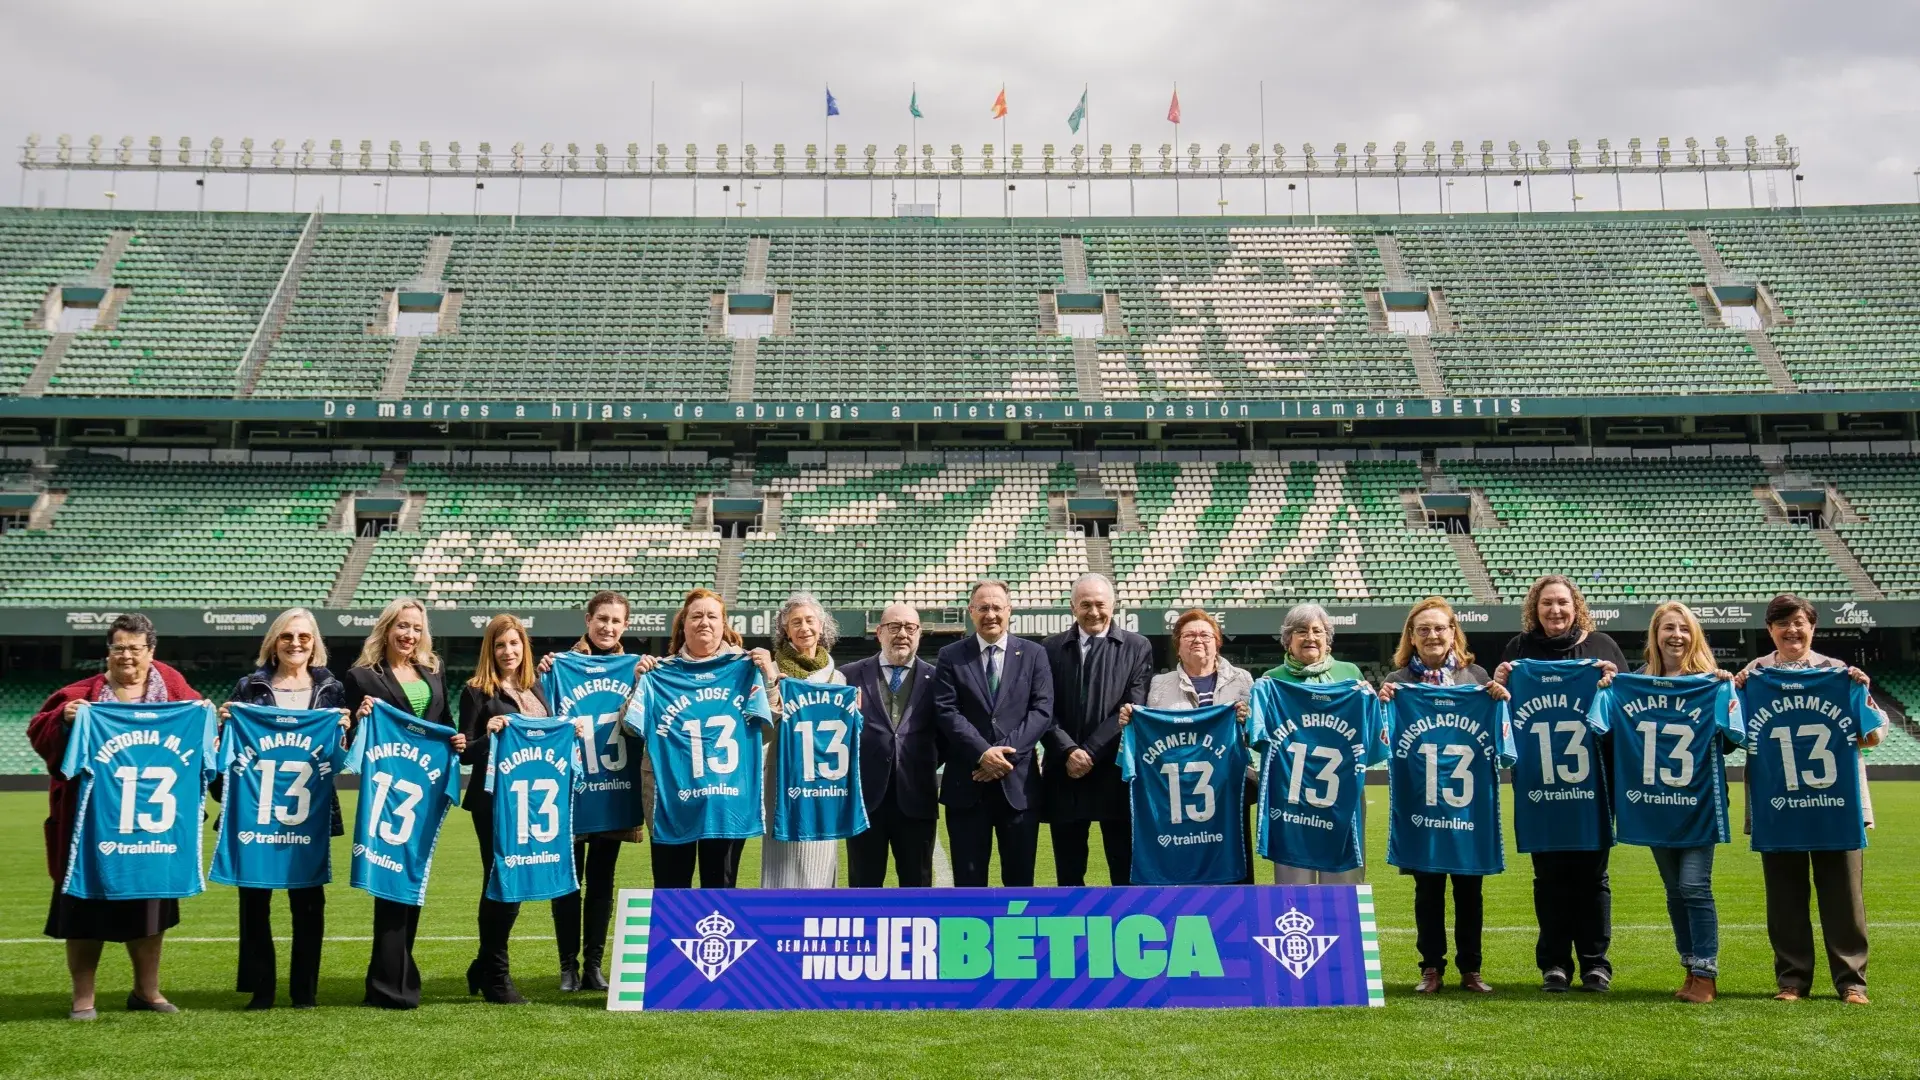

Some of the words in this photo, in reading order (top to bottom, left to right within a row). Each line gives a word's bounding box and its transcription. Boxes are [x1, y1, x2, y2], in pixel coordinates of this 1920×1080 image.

[324, 401, 355, 417] De
[378, 402, 489, 418] madres
[515, 403, 525, 417] a
[674, 402, 703, 418] de
[891, 402, 901, 418] a
[1064, 403, 1113, 417] una
[1146, 401, 1249, 419] pasión
[1281, 400, 1405, 418] llamada
[1431, 400, 1521, 415] BETIS
[66, 612, 122, 623] REVE
[203, 611, 267, 625] Cruzcampo
[751, 610, 771, 635] el
[1327, 613, 1357, 625] mmel
[1454, 611, 1489, 622] inline
[1690, 606, 1753, 617] REVEL
[1834, 617, 1877, 625] GLOBAL
[1847, 609, 1870, 617] AUS
[1009, 614, 1073, 636] anque
[573, 678, 632, 700] MERCED
[655, 694, 692, 738] MARIA
[696, 687, 731, 702] JOSE
[1513, 694, 1568, 730] ANTONIA
[1573, 698, 1585, 713] L.
[1622, 694, 1668, 718] PILAR
[1301, 713, 1357, 741] BRIGIDA
[1396, 713, 1480, 759] CONSOLACION
[1748, 708, 1772, 755] MARIA
[1771, 695, 1844, 721] CARMEN
[94, 730, 160, 764] VICTORIA
[233, 745, 258, 777] ANA
[259, 732, 313, 752] MARIA
[366, 742, 418, 763] VANESA
[577, 712, 628, 775] 13
[681, 714, 740, 779] 13
[794, 720, 849, 782] 13
[1142, 732, 1197, 765] CARMEN
[1529, 720, 1590, 785] 13
[1636, 720, 1696, 788] 13
[499, 746, 542, 775] GLORIA
[1769, 723, 1838, 792] 13
[588, 779, 632, 792] trainline
[1286, 741, 1344, 808] 13
[1417, 743, 1475, 808] 13
[114, 766, 178, 834] 13
[253, 760, 314, 826] 13
[693, 783, 740, 798] trainline
[1160, 761, 1216, 824] 13
[1543, 787, 1595, 801] trainline
[1643, 792, 1698, 806] trainline
[1788, 794, 1846, 809] trainline
[369, 771, 424, 845] 13
[510, 779, 560, 844] 13
[1282, 810, 1334, 831] trainline
[1424, 816, 1475, 831] trainline
[118, 841, 177, 854] trainline
[256, 831, 312, 845] trainline
[1173, 832, 1223, 846] trainline
[516, 850, 561, 866] trainline
[777, 939, 827, 952] SEMANA
[835, 939, 849, 952] DE
[856, 939, 871, 952] LA
[801, 917, 938, 981] MUJER
[938, 901, 1225, 980] BÉTICA
